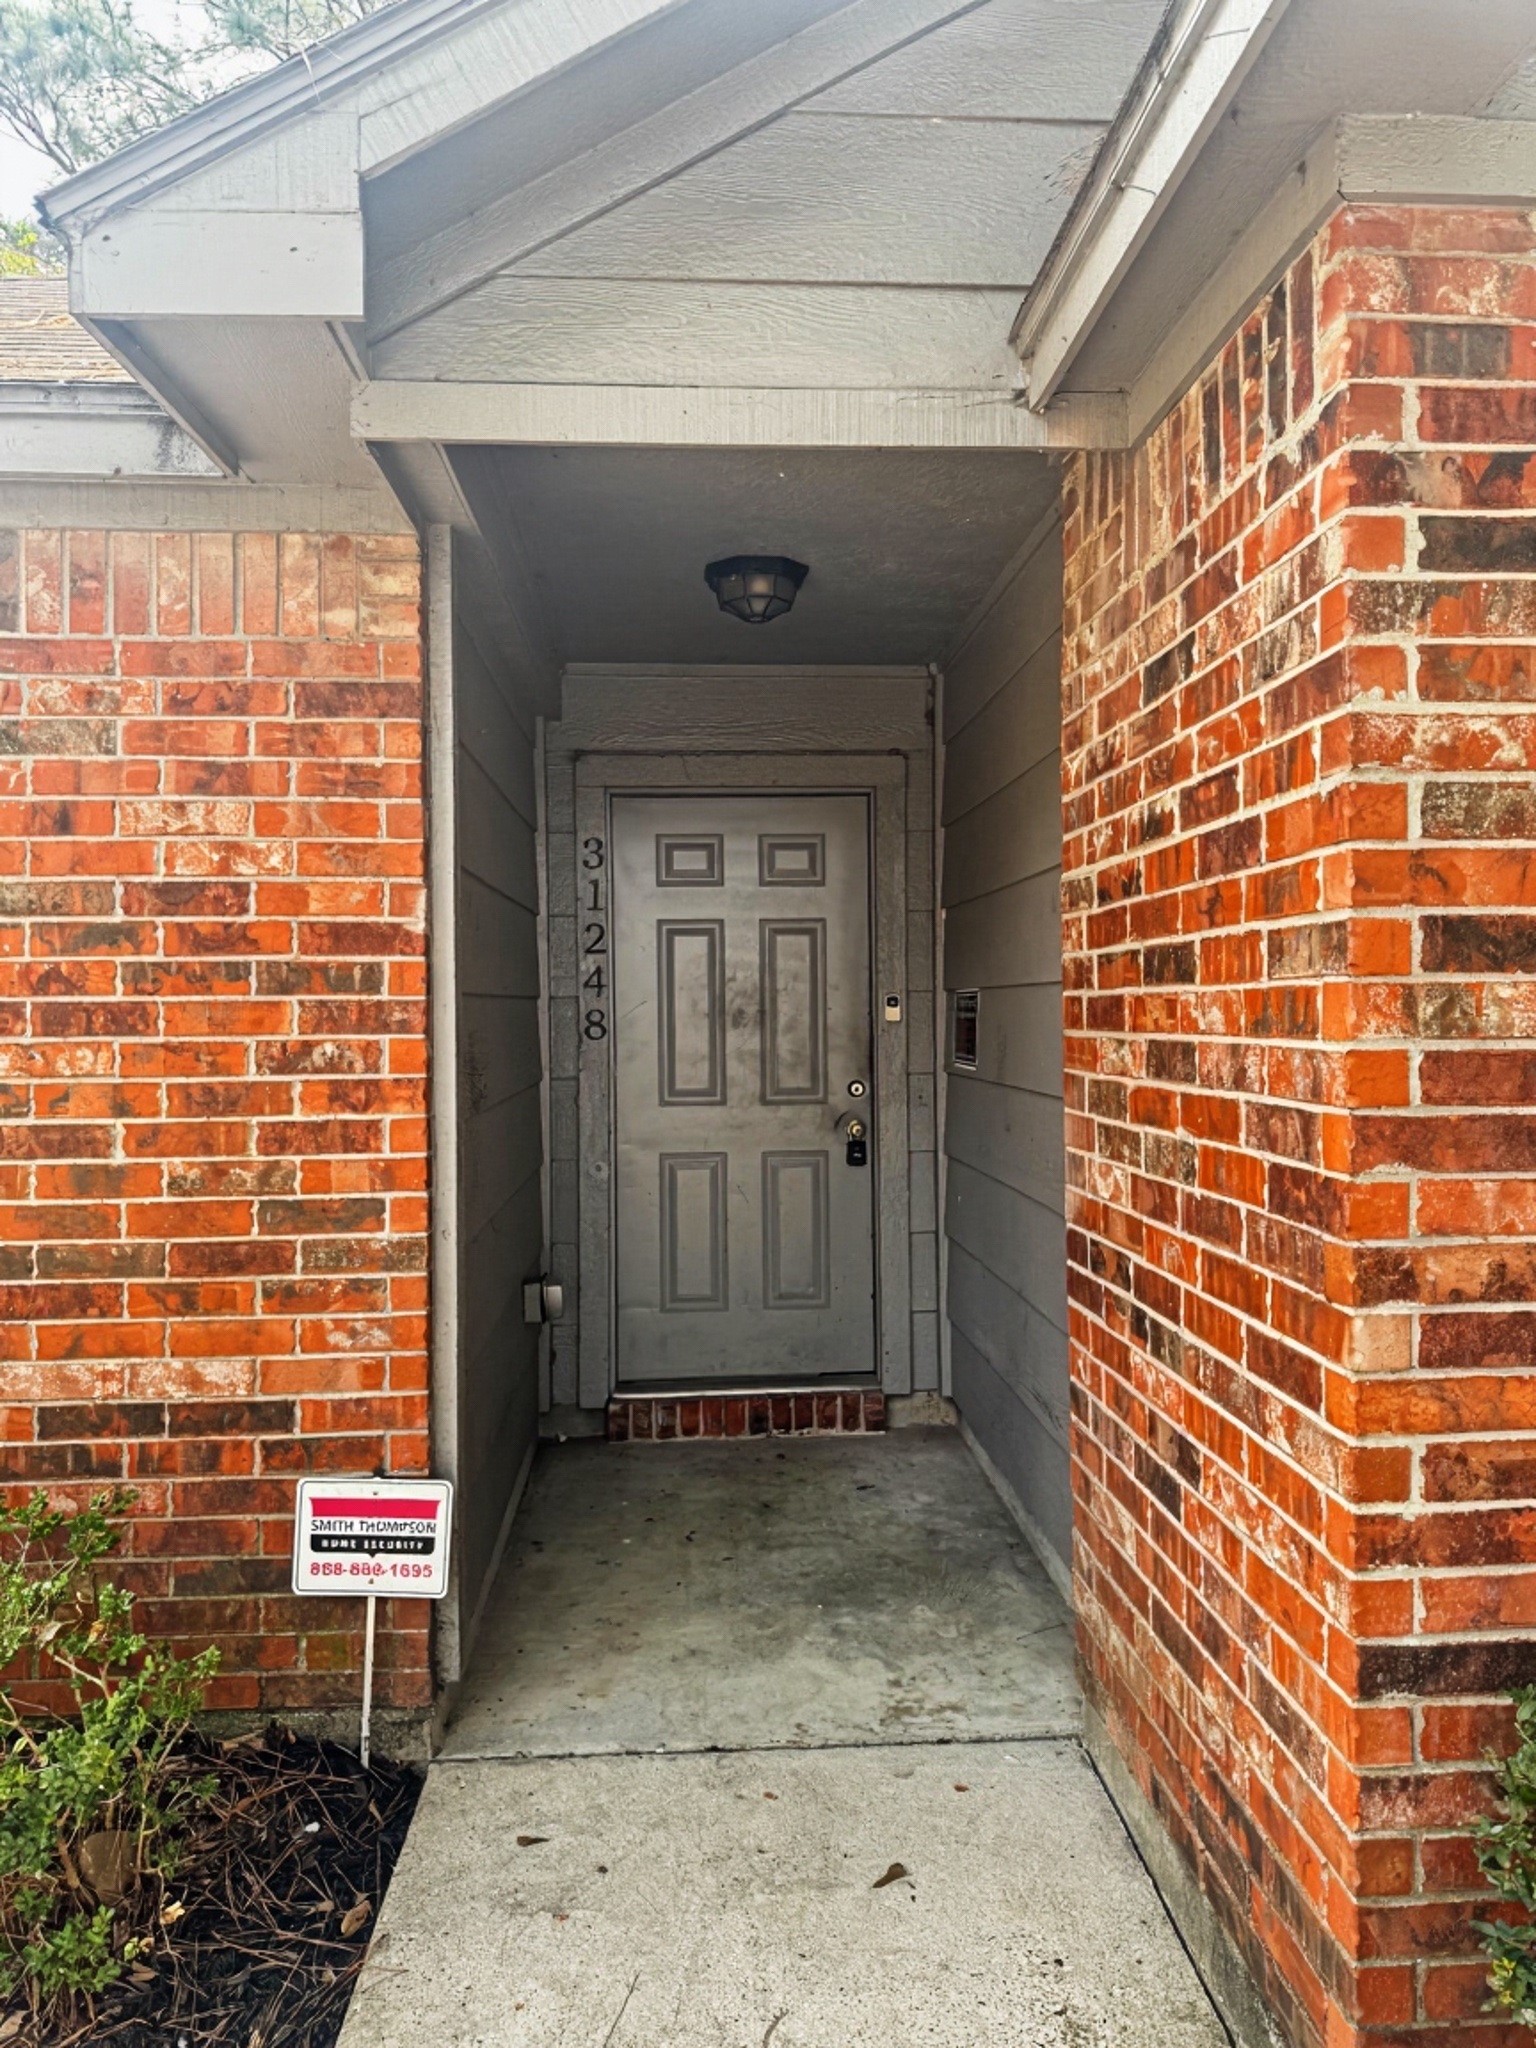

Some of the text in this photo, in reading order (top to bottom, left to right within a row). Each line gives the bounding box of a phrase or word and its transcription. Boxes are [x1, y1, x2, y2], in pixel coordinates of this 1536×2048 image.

[582, 836, 608, 1041] 31248
[311, 1519, 436, 1534] SMITH THOMPSON
